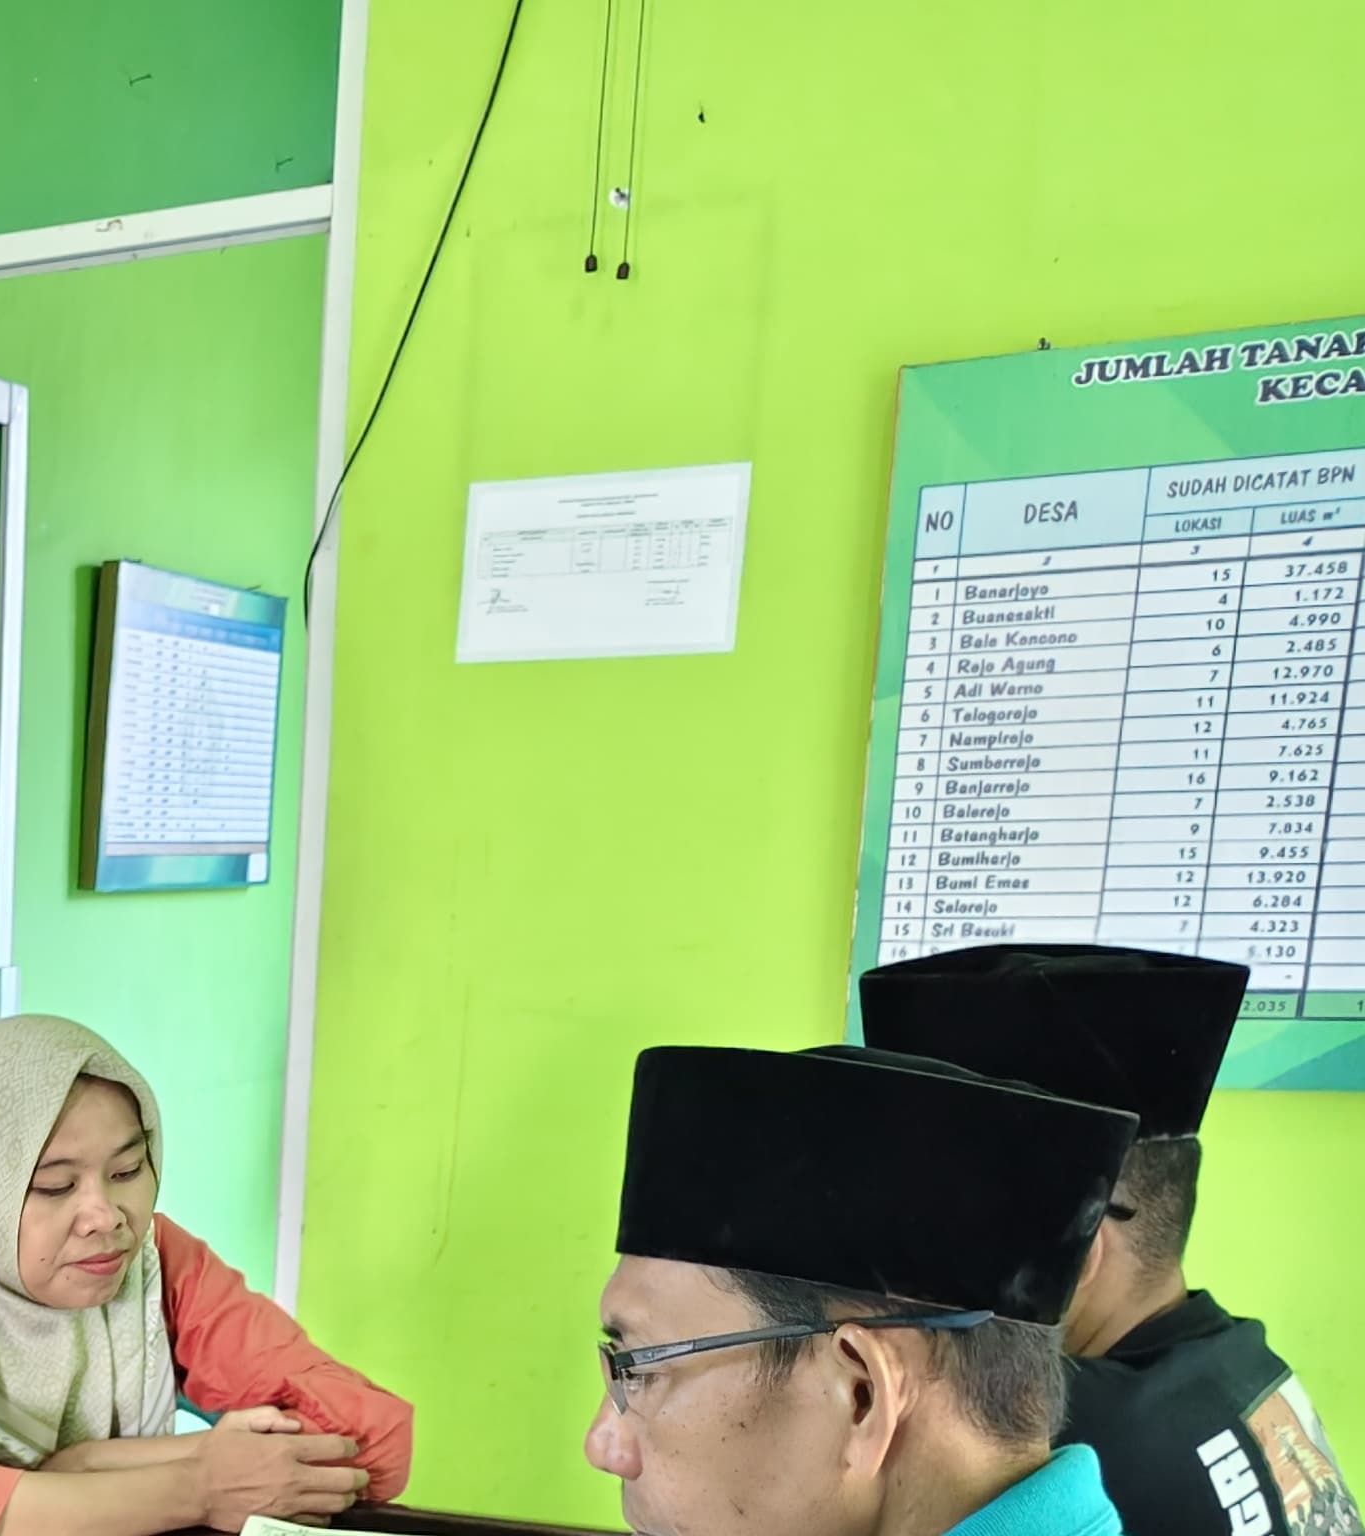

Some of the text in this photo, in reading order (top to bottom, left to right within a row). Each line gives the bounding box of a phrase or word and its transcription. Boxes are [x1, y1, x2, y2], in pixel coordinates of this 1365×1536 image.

[1073, 346, 1233, 386] JUMLAH
[1257, 368, 1365, 403] KECA
[1167, 464, 1356, 499] SUDAH DICATAT BPN
[925, 500, 1079, 533] NO DESA
[1174, 516, 1222, 533] LOKASI
[1280, 508, 1316, 525] LUAS
[935, 587, 940, 601] 1
[1212, 568, 1231, 582] 15
[1284, 561, 1349, 578] 37.458
[930, 611, 940, 626] 2
[1219, 593, 1228, 605] 4
[1295, 586, 1344, 602] 1.172
[929, 637, 937, 650] 3
[1206, 618, 1225, 631] 10
[1288, 611, 1342, 627] 4.990
[926, 661, 935, 675] 4
[1211, 644, 1221, 656] 6
[1285, 638, 1339, 654] 2.485
[924, 685, 932, 699] 5
[1209, 669, 1219, 682] 7
[1272, 664, 1334, 680] 12.970
[920, 709, 930, 723] 6
[1196, 695, 1215, 708] 11
[1269, 691, 1330, 706] 11.924
[919, 734, 928, 747] 7
[1193, 720, 1212, 734] 12
[1281, 717, 1328, 731] 4.765
[916, 757, 925, 771] 8
[1193, 748, 1209, 760] 11
[1278, 743, 1324, 757] 7.625
[914, 781, 924, 795] 9
[1187, 772, 1206, 785] 16
[1269, 769, 1319, 784] 9.162
[905, 805, 922, 819] 10
[1194, 797, 1203, 809] 7
[1265, 794, 1316, 808] 2.538
[903, 830, 918, 843] 11
[1190, 823, 1200, 835] 9
[1268, 822, 1314, 835] 7.834
[900, 853, 917, 867] 12
[1179, 846, 1198, 860] 15
[1259, 845, 1310, 860] 9.455
[898, 876, 914, 890] 13
[1175, 870, 1194, 884] 12
[1247, 870, 1306, 884] 13.920
[896, 900, 912, 913] 14
[1173, 894, 1192, 907] 12
[1252, 895, 1303, 908] 6.284
[894, 923, 910, 936] 15
[1179, 919, 1189, 933] 7
[1249, 919, 1300, 933] 4.323
[1242, 1000, 1287, 1012] 2.035
